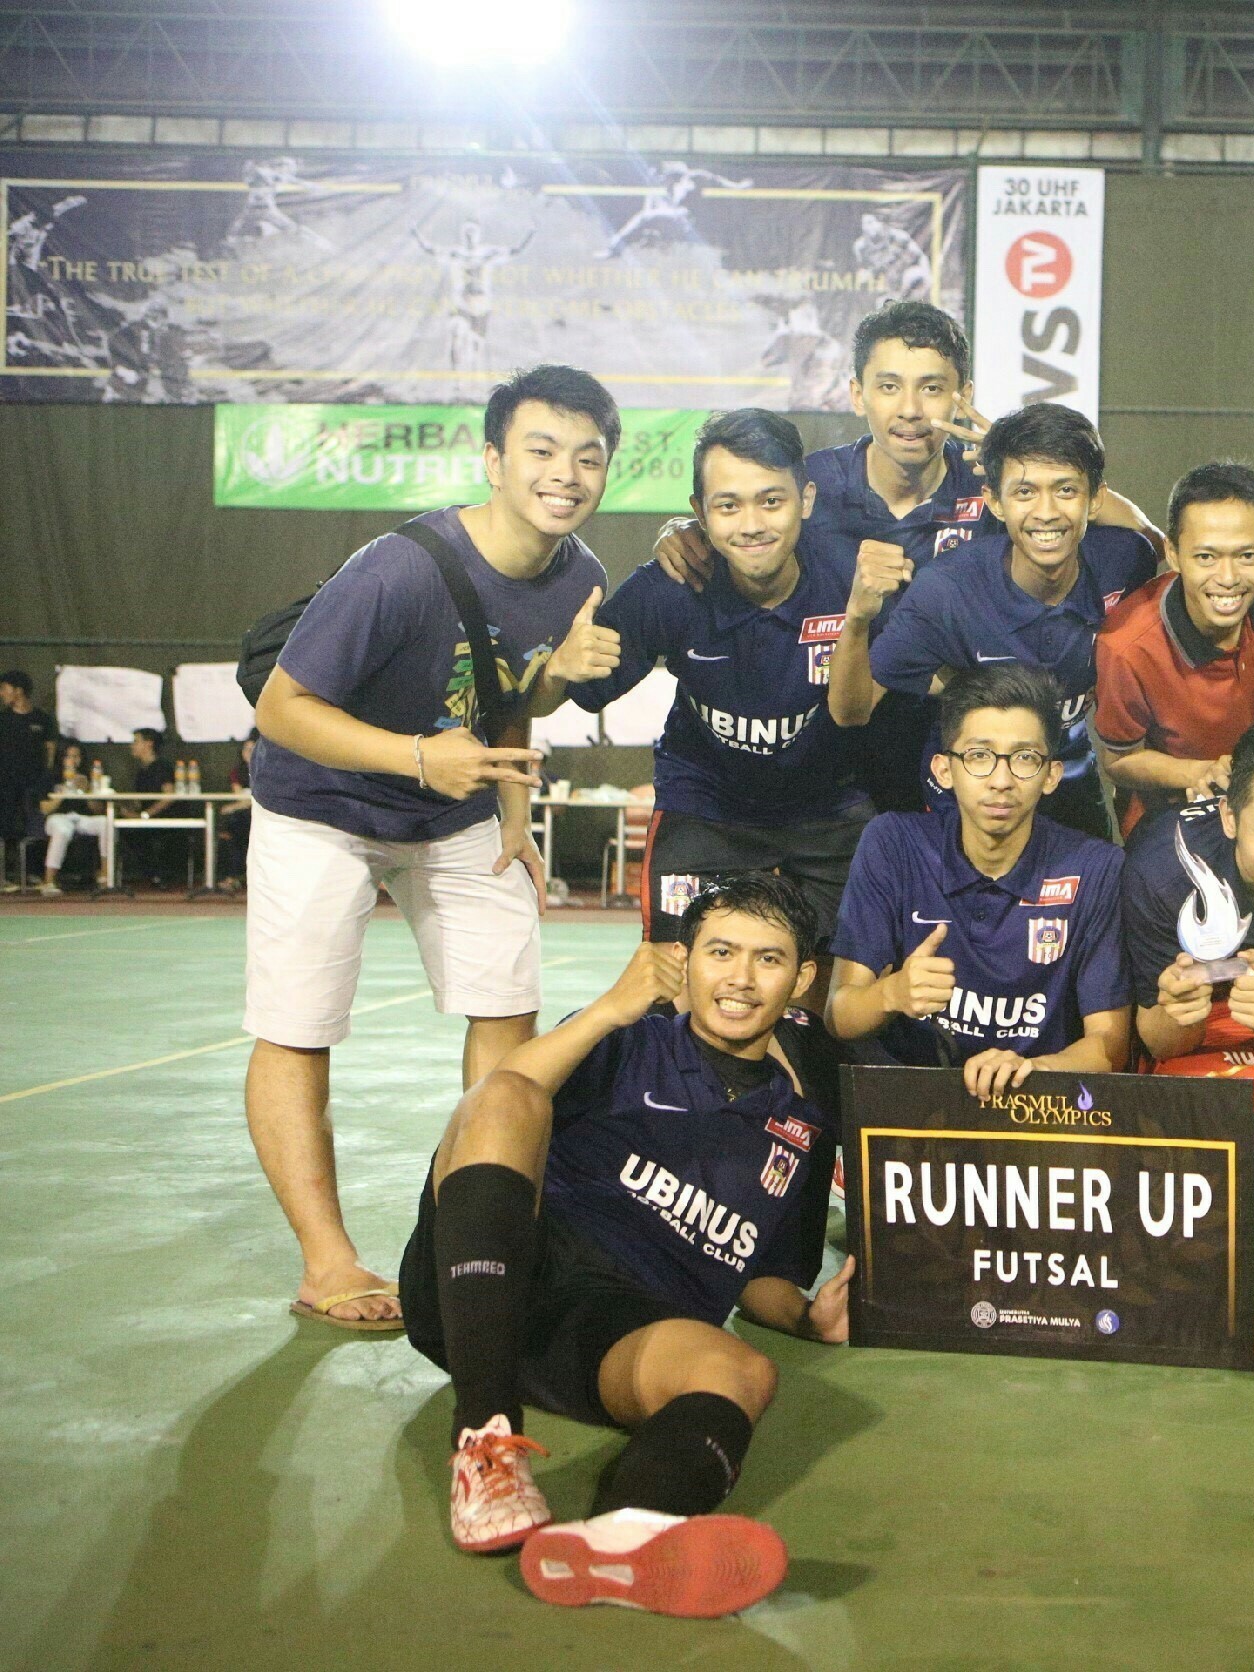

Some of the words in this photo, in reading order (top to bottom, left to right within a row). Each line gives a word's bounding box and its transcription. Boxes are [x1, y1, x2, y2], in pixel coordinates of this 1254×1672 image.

[1005, 178, 1029, 196] 30
[1037, 180, 1081, 196] UHF
[992, 199, 1088, 216] JAKARTA
[996, 1026, 1040, 1039] CLUB
[1010, 1102, 1113, 1126] OLYMPICS
[619, 1153, 758, 1258] UBINUS
[883, 1160, 1113, 1234] RUNNER
[1138, 1171, 1213, 1239] UP
[702, 1243, 746, 1273] CLUB
[973, 1248, 1119, 1289] FUTSAL
[1050, 1316, 1081, 1328] MULYA
